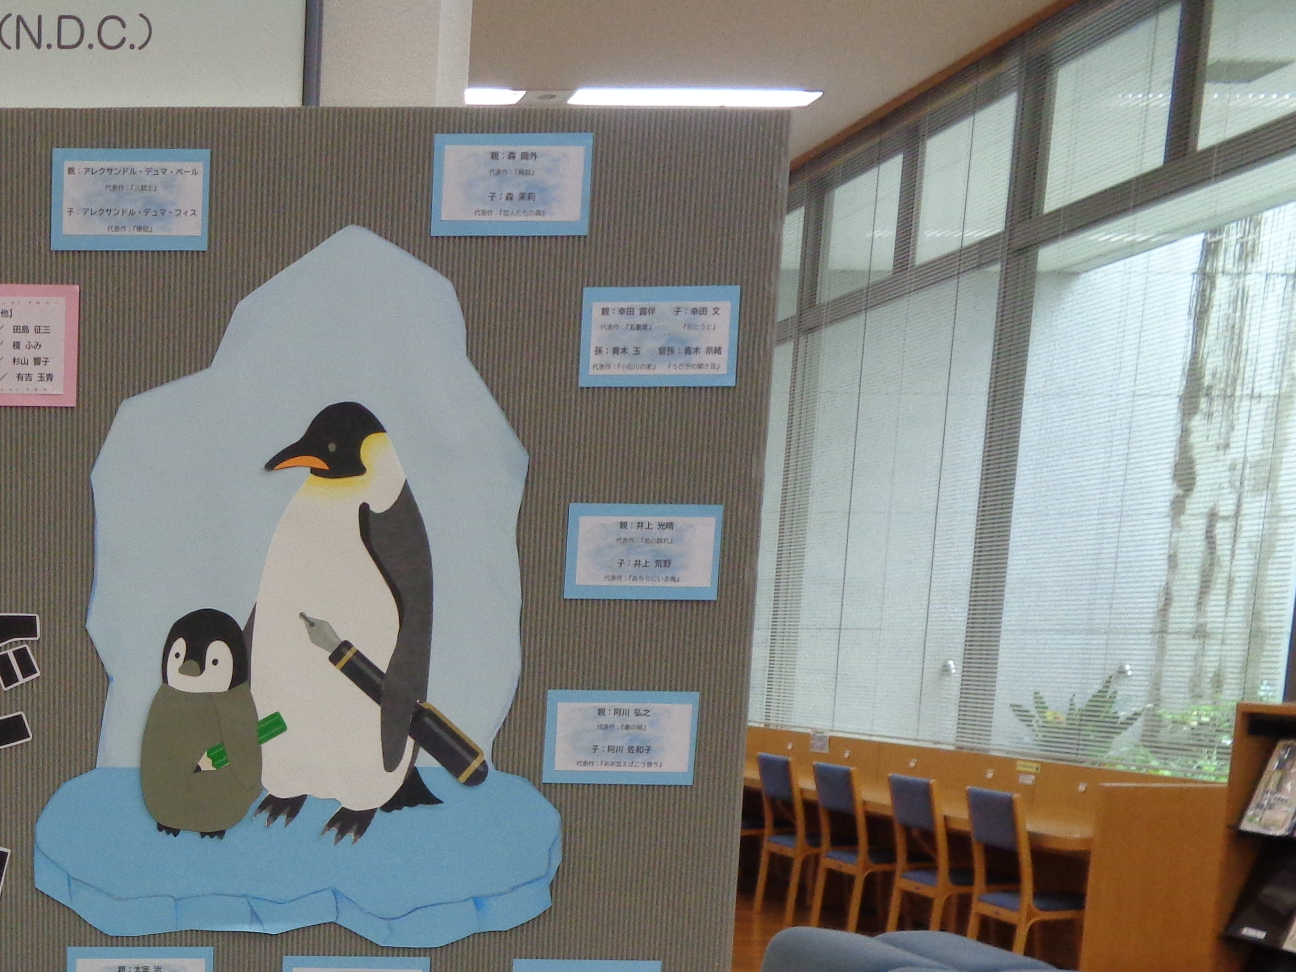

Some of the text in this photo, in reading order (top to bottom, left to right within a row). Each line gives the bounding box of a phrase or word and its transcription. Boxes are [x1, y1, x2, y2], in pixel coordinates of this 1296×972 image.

[711, 306, 720, 316] 文
[13, 325, 29, 334] 田島
[34, 325, 51, 334] 征三
[25, 340, 42, 349] ふみ
[12, 357, 29, 366] 杉山
[16, 373, 32, 382] 有吉
[634, 708, 651, 717] 弘之
[626, 744, 652, 754] 佐和子
